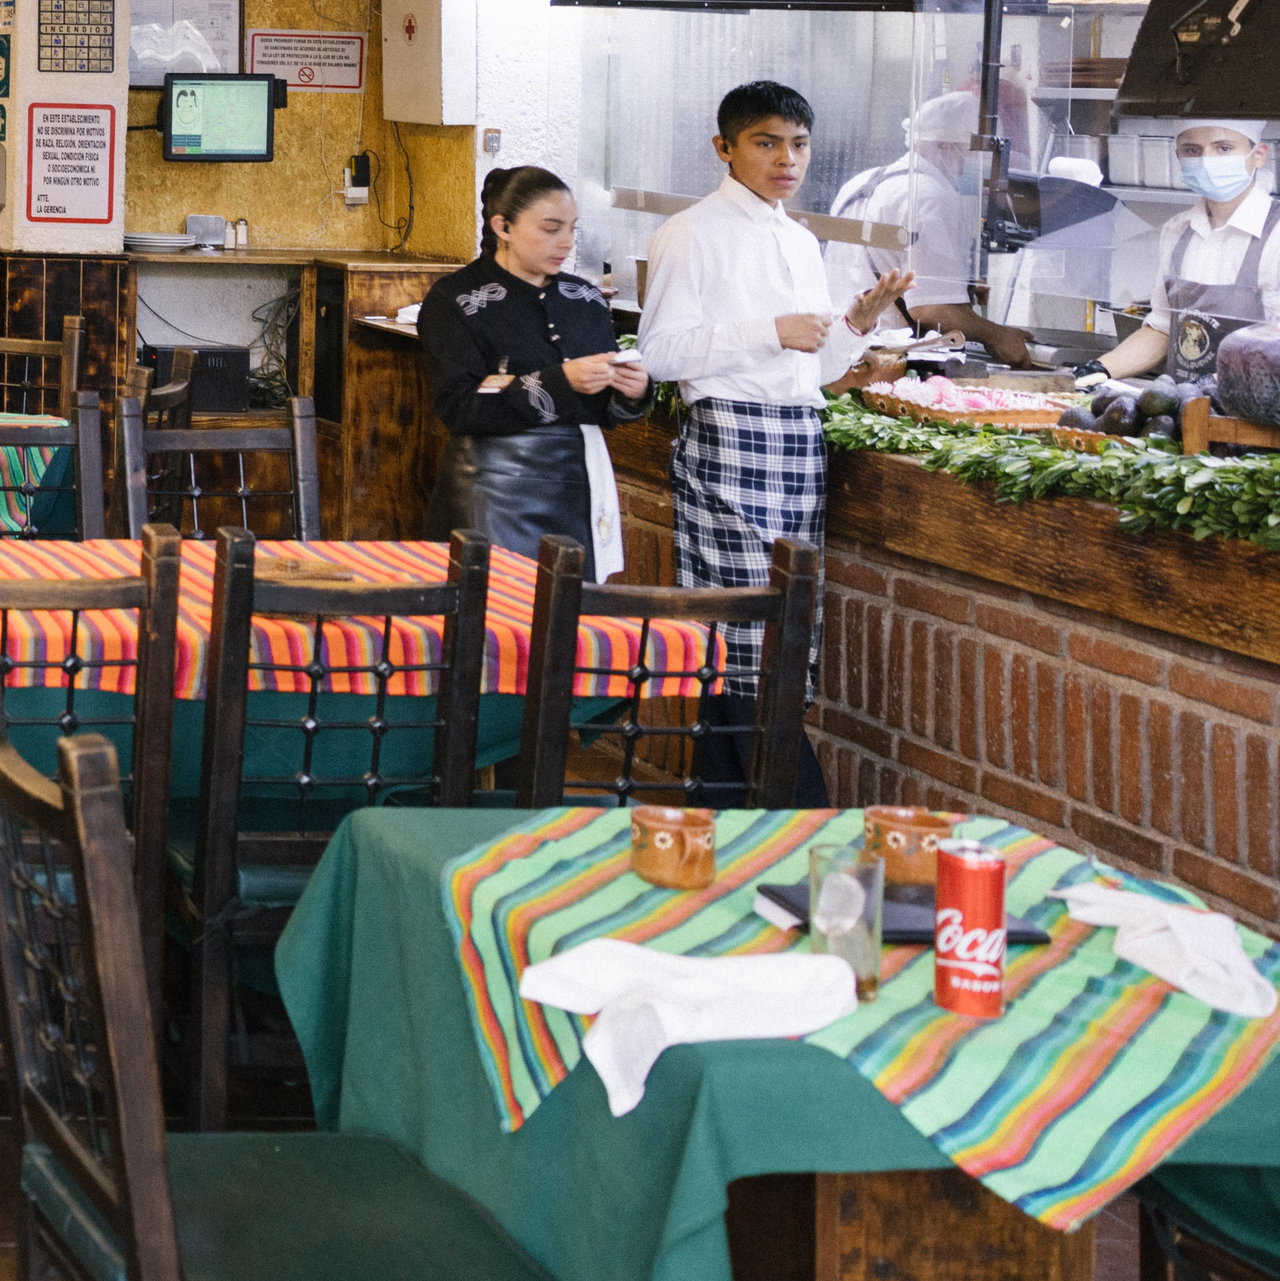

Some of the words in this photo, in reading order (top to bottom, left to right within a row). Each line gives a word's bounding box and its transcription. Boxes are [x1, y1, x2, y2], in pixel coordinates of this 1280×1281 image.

[43, 114, 49, 122] EN
[50, 114, 60, 122] ESTE
[61, 114, 100, 124] ESTABLECIMIENTO
[37, 127, 43, 135] NO
[45, 127, 50, 135] SE
[51, 127, 75, 136] DISCRIMINA
[77, 127, 85, 136] POR
[86, 128, 105, 136] MOTIVOS
[36, 139, 42, 148] DE
[78, 140, 106, 149] ORIENTACION
[61, 152, 84, 160] CONDICION
[86, 152, 99, 161] FISICA
[48, 164, 50, 172] O
[52, 164, 90, 173] SOCIOECONOMICA
[90, 165, 95, 174] NI
[43, 176, 52, 185] POR
[53, 177, 70, 185] NINGUN
[71, 177, 82, 186] OTRO
[83, 178, 99, 186] MOTIVO
[37, 205, 42, 213] LA
[44, 206, 66, 214] GERENCIA
